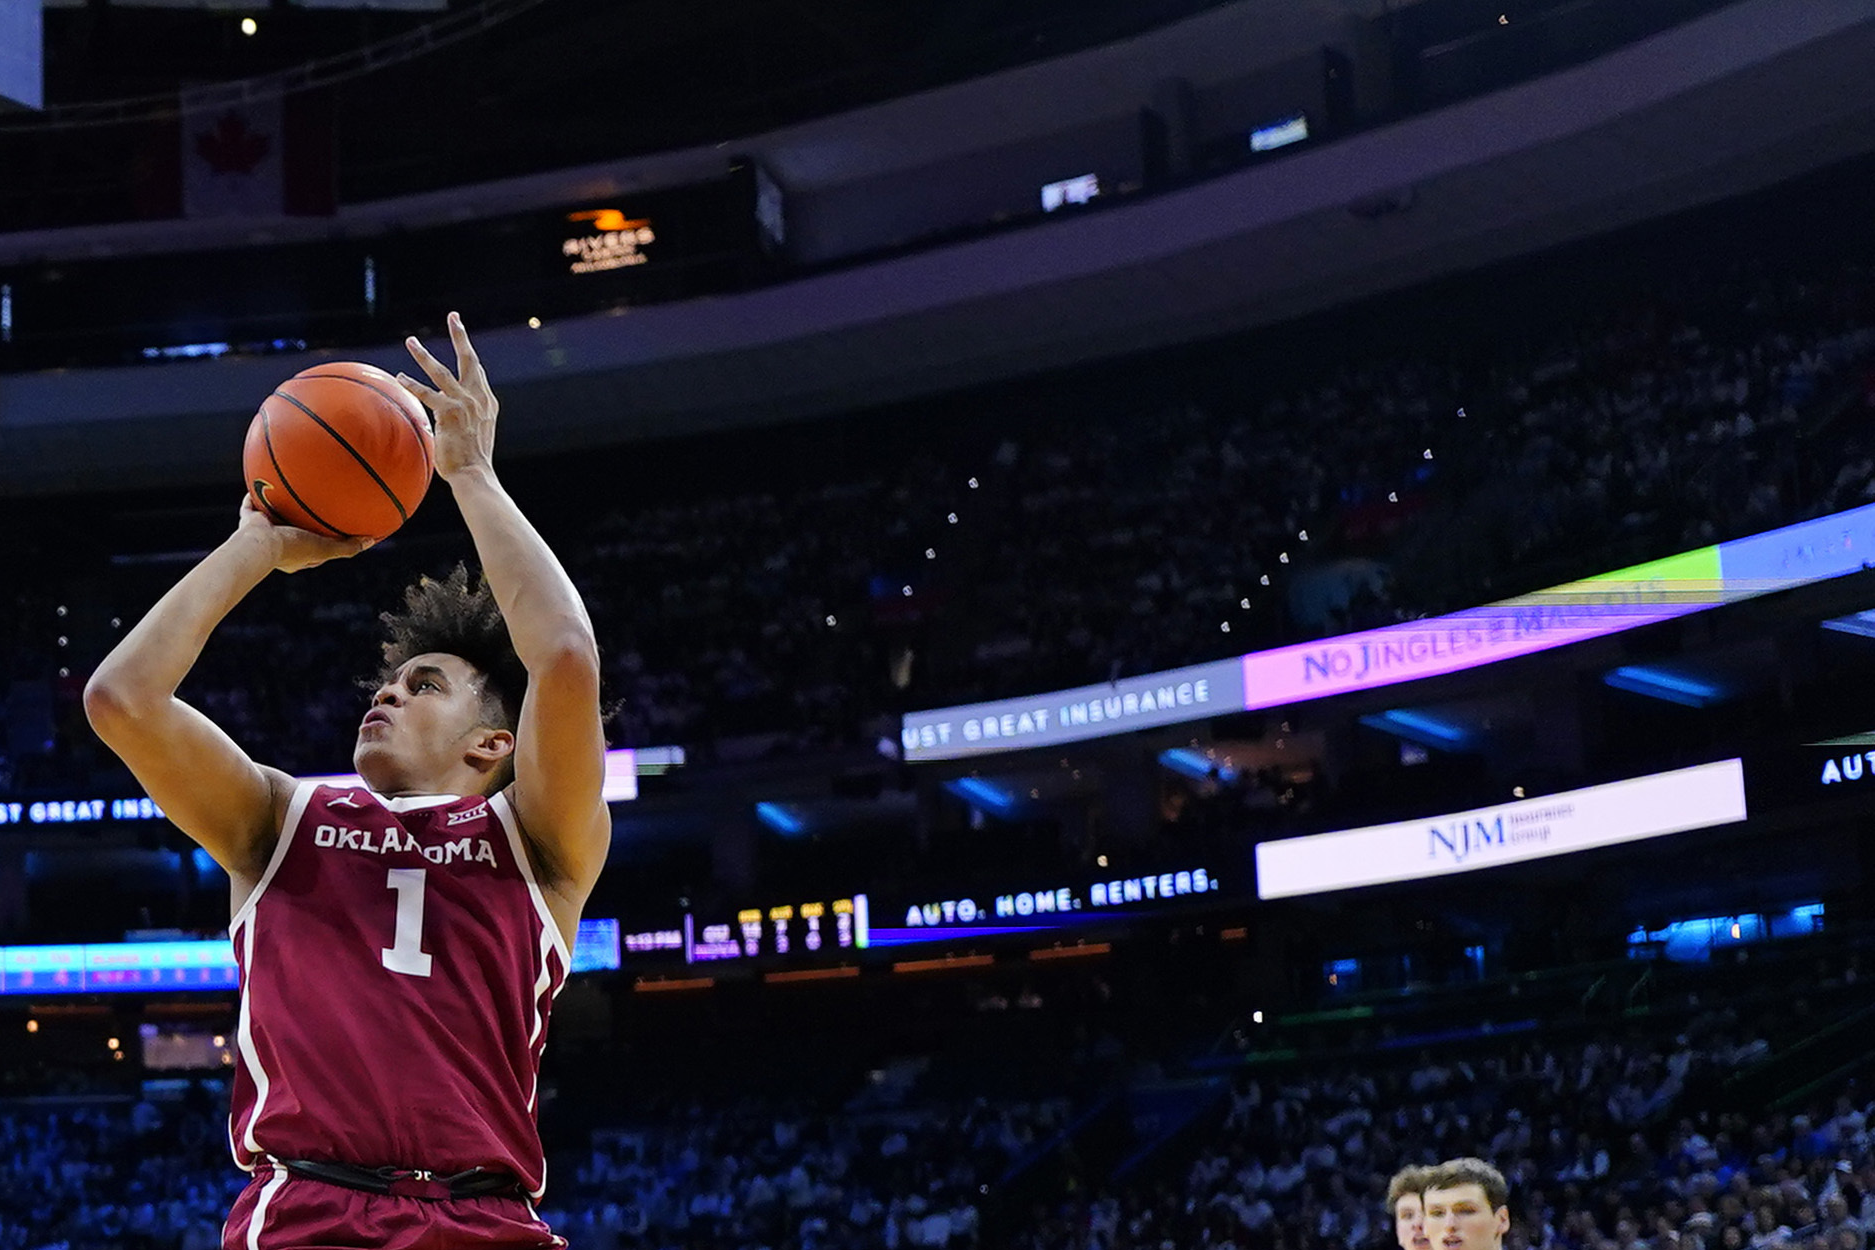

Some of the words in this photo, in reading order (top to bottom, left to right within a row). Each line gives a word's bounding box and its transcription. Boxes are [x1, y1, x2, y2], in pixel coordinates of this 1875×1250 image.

[1303, 653, 1352, 683] NO
[1355, 630, 1483, 680] JINGLES
[962, 709, 1050, 742] GREAT
[1059, 679, 1210, 728] INSURANCE
[29, 800, 106, 824] GREAT
[314, 824, 498, 869] OKLAHOMA
[1428, 813, 1505, 863] NJM
[381, 868, 433, 978] 1
